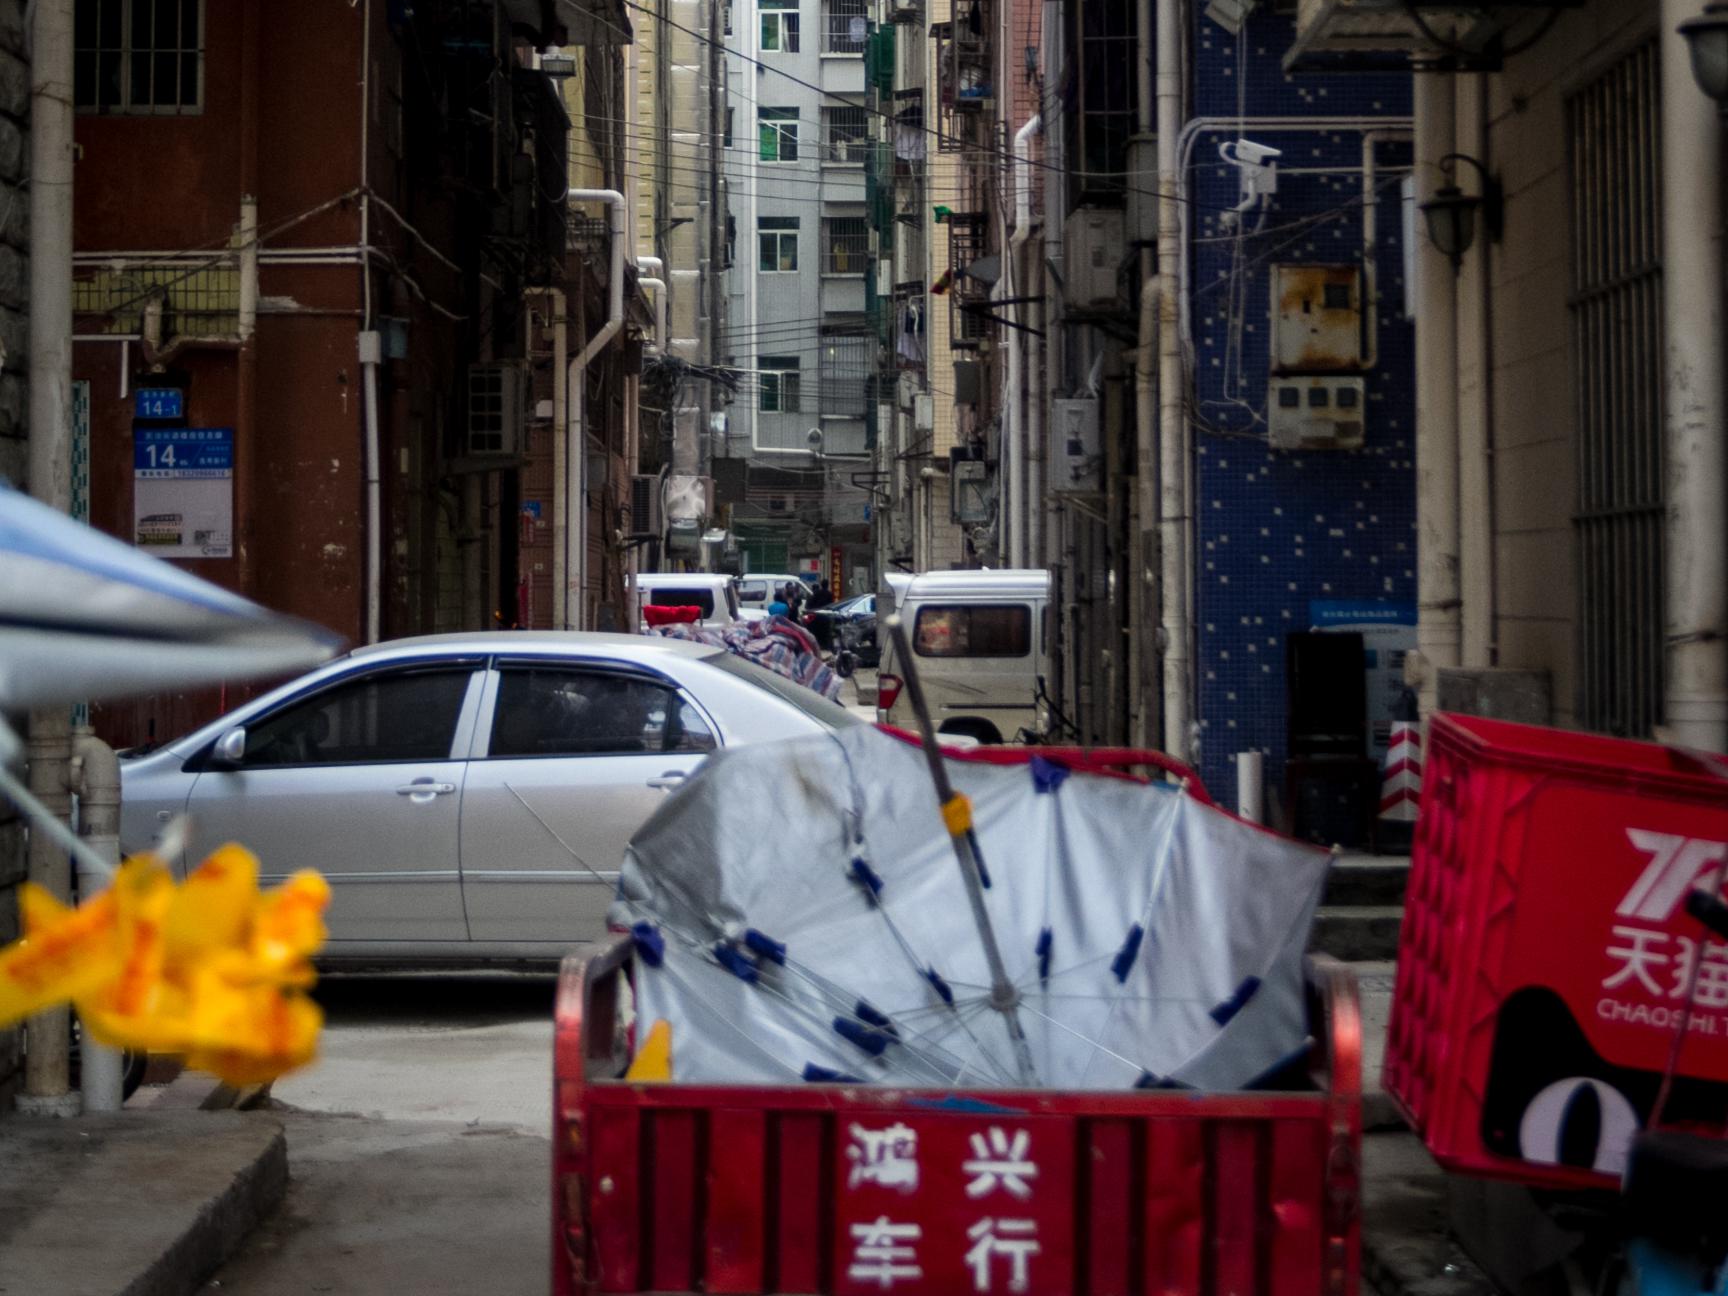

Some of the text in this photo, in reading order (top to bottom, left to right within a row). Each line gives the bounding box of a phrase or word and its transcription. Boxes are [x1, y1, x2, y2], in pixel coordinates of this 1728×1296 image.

[143, 400, 177, 416] 14-1
[1601, 924, 1728, 1008] 天猫
[847, 1214, 1042, 1293] 车行
